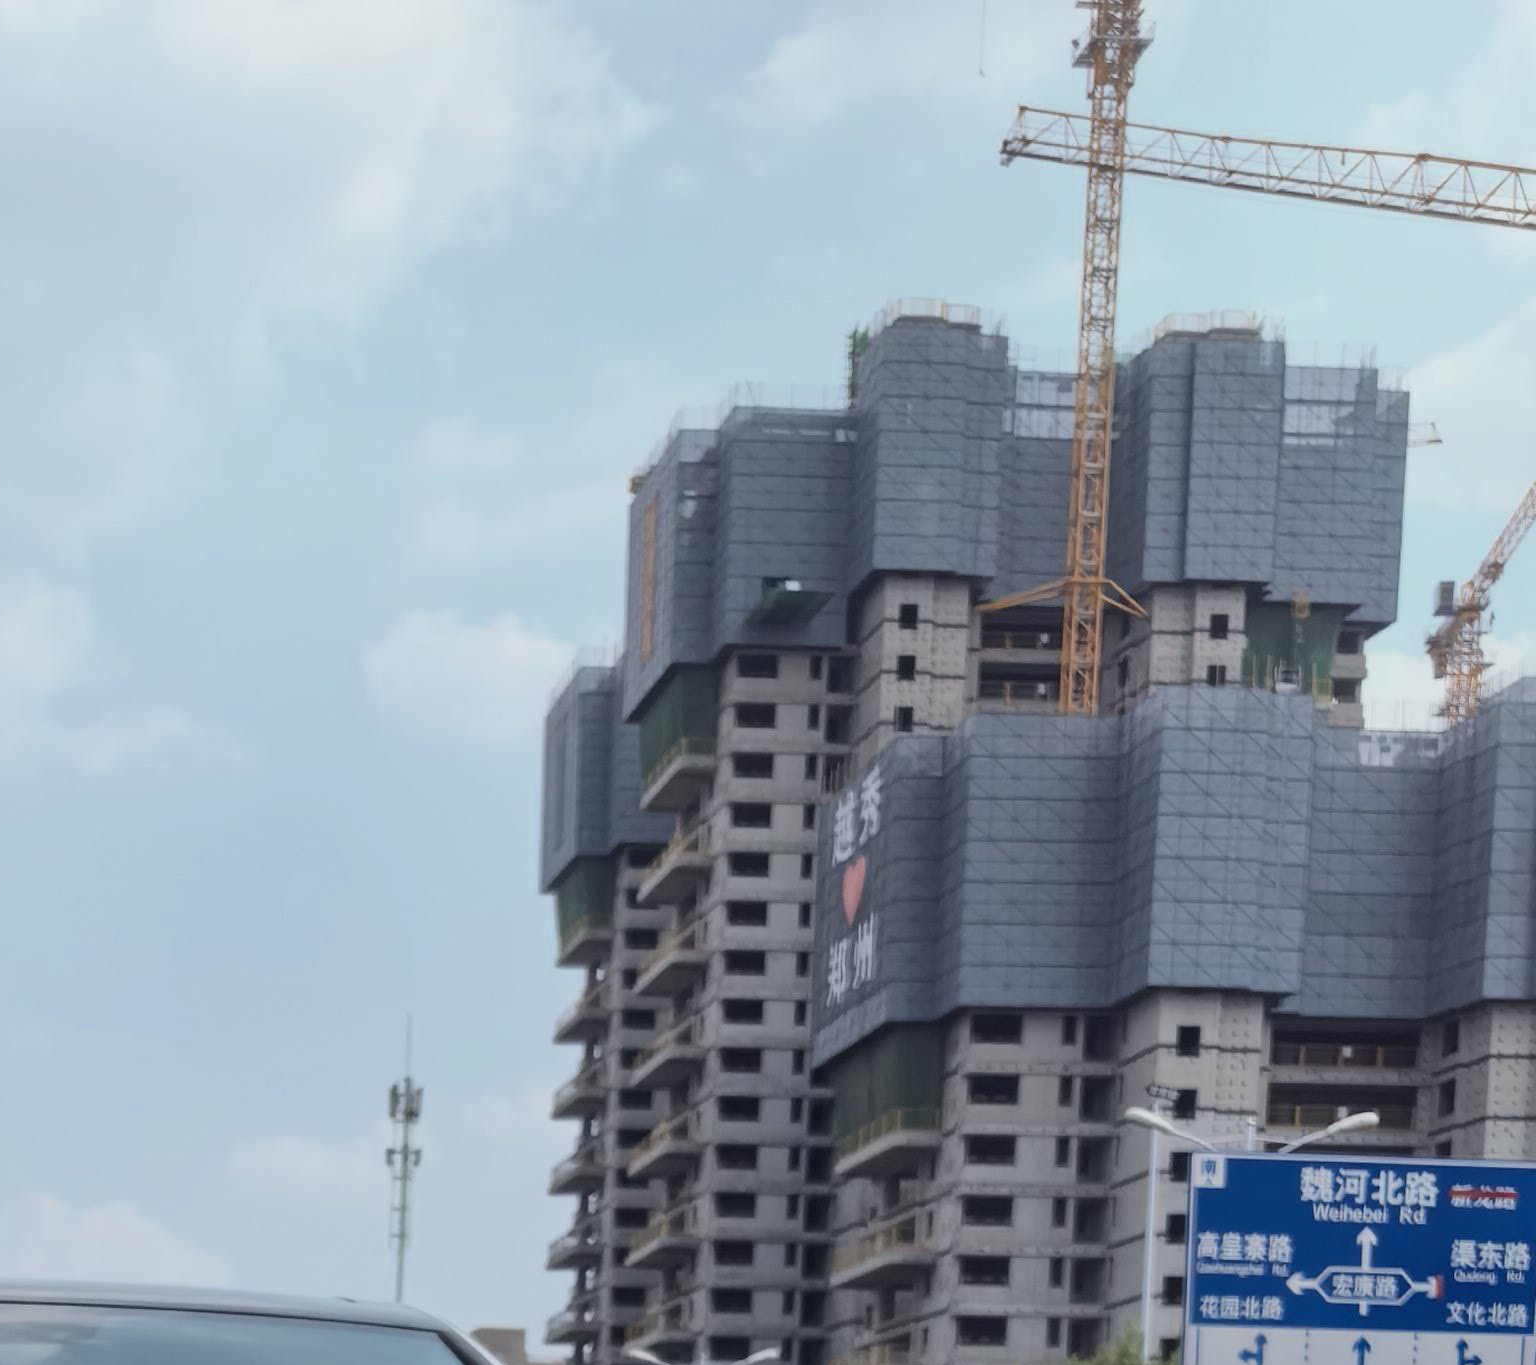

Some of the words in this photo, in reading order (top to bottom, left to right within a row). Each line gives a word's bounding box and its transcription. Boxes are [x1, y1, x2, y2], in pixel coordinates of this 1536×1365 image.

[826, 912, 875, 1008] 郑州
[1300, 1166, 1439, 1208] 魏河北路
[1312, 1202, 1389, 1224] Weihebei
[1399, 1205, 1427, 1225] Rd
[1196, 1231, 1294, 1263] 高皇寨路
[1450, 1239, 1531, 1271] 渠东路
[1200, 1294, 1285, 1321] 花园北路
[1446, 1301, 1529, 1328] 文化北路
